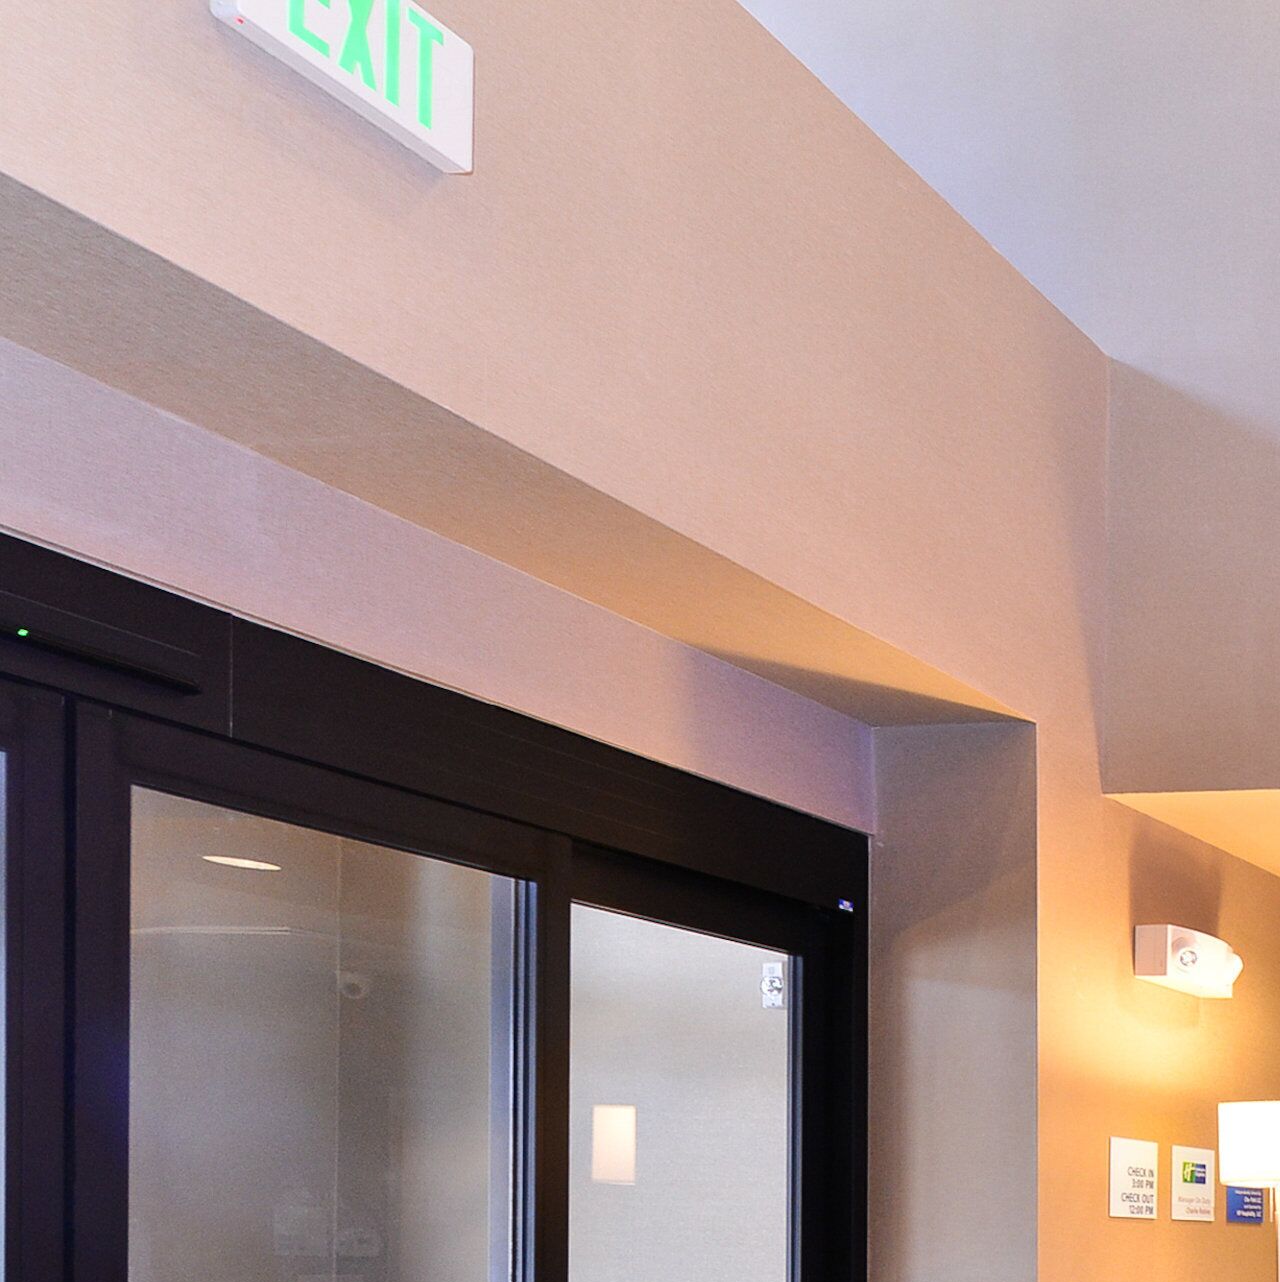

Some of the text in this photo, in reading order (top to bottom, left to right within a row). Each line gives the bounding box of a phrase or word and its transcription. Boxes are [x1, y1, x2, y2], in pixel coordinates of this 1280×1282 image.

[1127, 1166, 1146, 1177] CHECK
[1121, 1192, 1154, 1204] CHECK OUT
